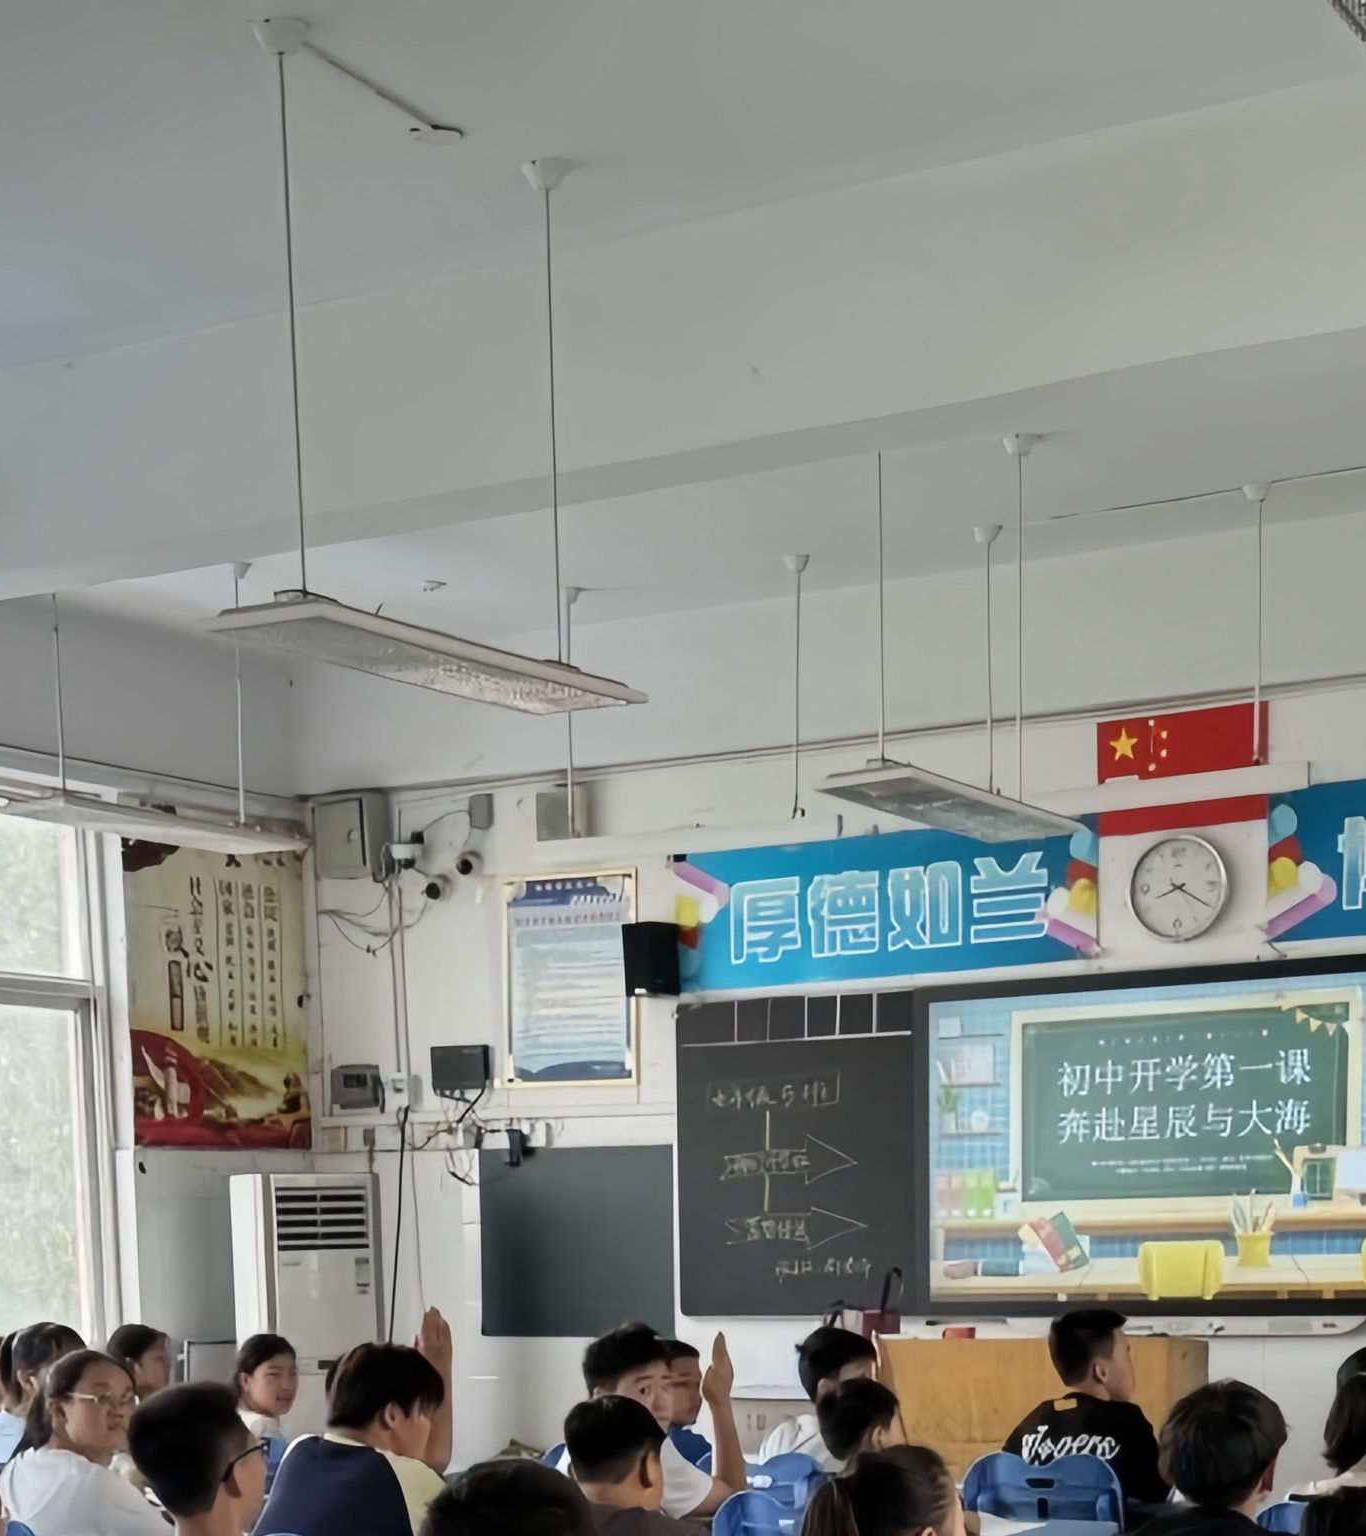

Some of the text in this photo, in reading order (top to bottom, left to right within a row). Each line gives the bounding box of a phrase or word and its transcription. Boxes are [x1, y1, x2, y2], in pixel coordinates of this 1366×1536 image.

[729, 850, 1049, 966] 厚德如兰
[1057, 1048, 1312, 1097] 初中开学第一课
[1057, 1098, 1312, 1144] 奔赴星辰与大海
